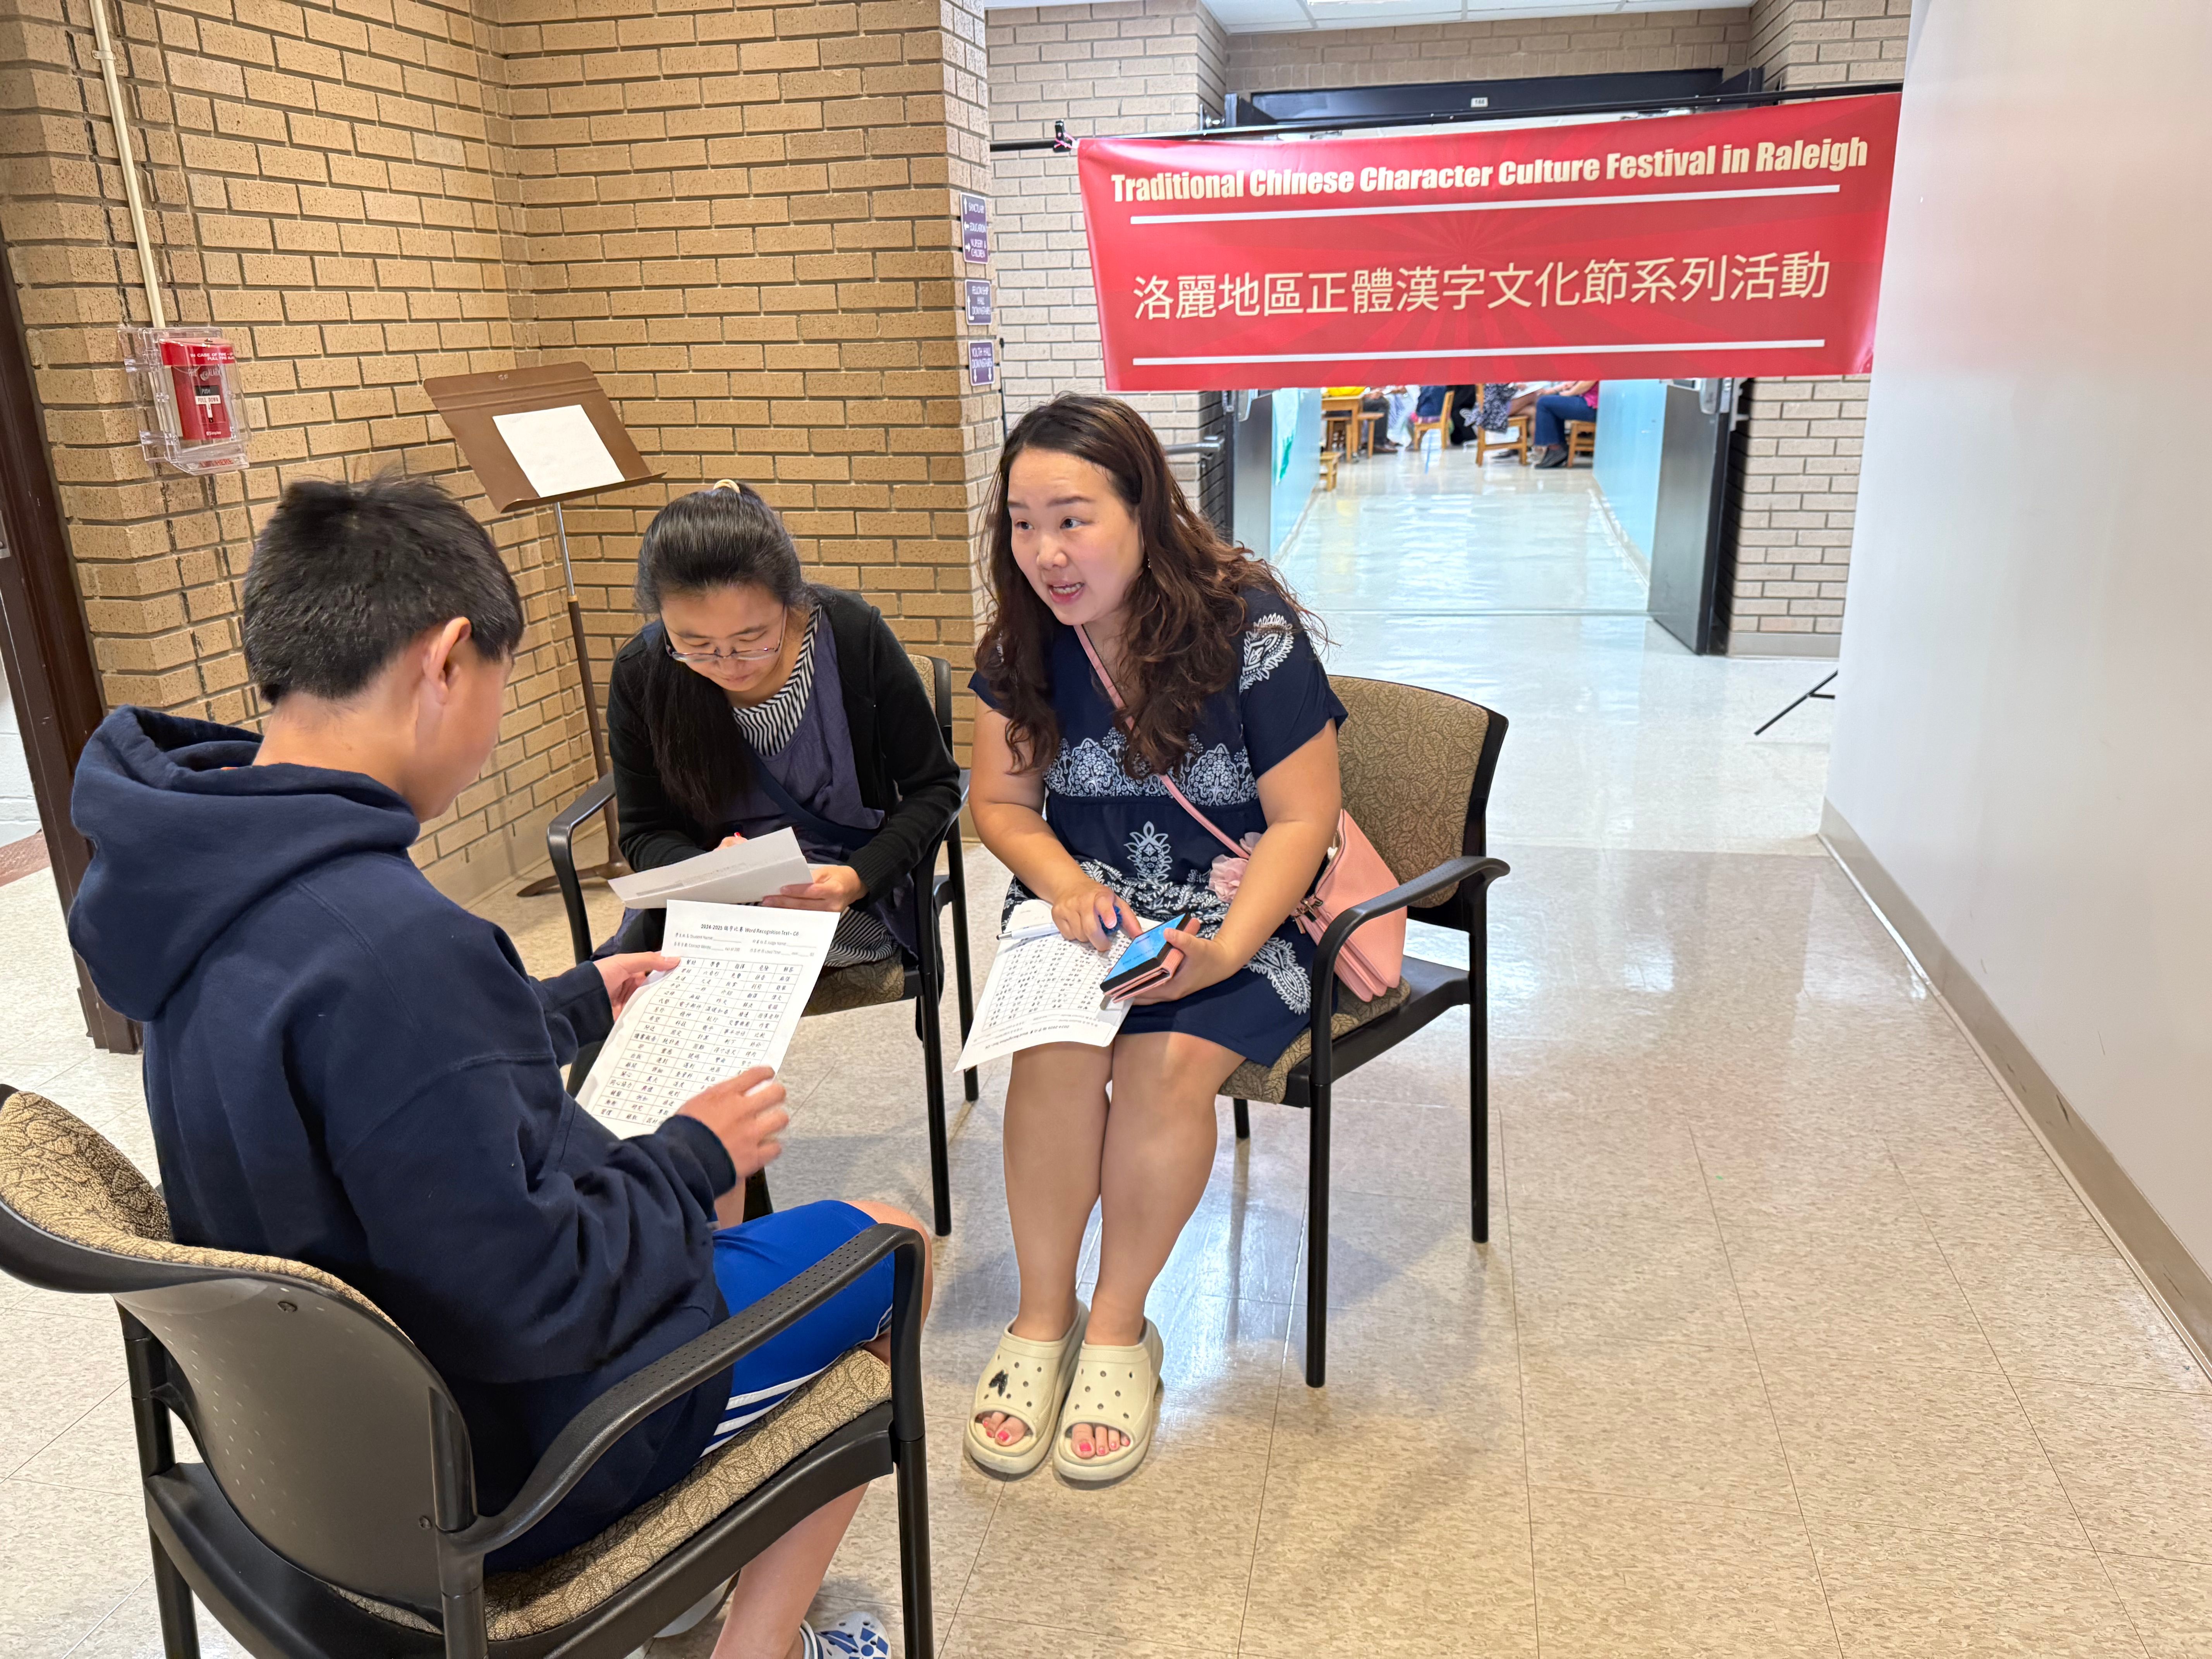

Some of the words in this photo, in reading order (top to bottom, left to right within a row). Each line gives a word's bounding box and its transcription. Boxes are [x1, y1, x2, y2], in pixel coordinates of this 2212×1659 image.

[1111, 170, 1244, 202] Traditional
[1249, 168, 1355, 197] Chinese
[1360, 165, 1493, 192] Character
[1498, 158, 1600, 186] Culture
[1606, 145, 1717, 180] Festival
[1721, 144, 1750, 174] in
[1755, 136, 1867, 172] Raleigh
[1133, 250, 1830, 320] 洛麗地區正體漢字文化節系列活動
